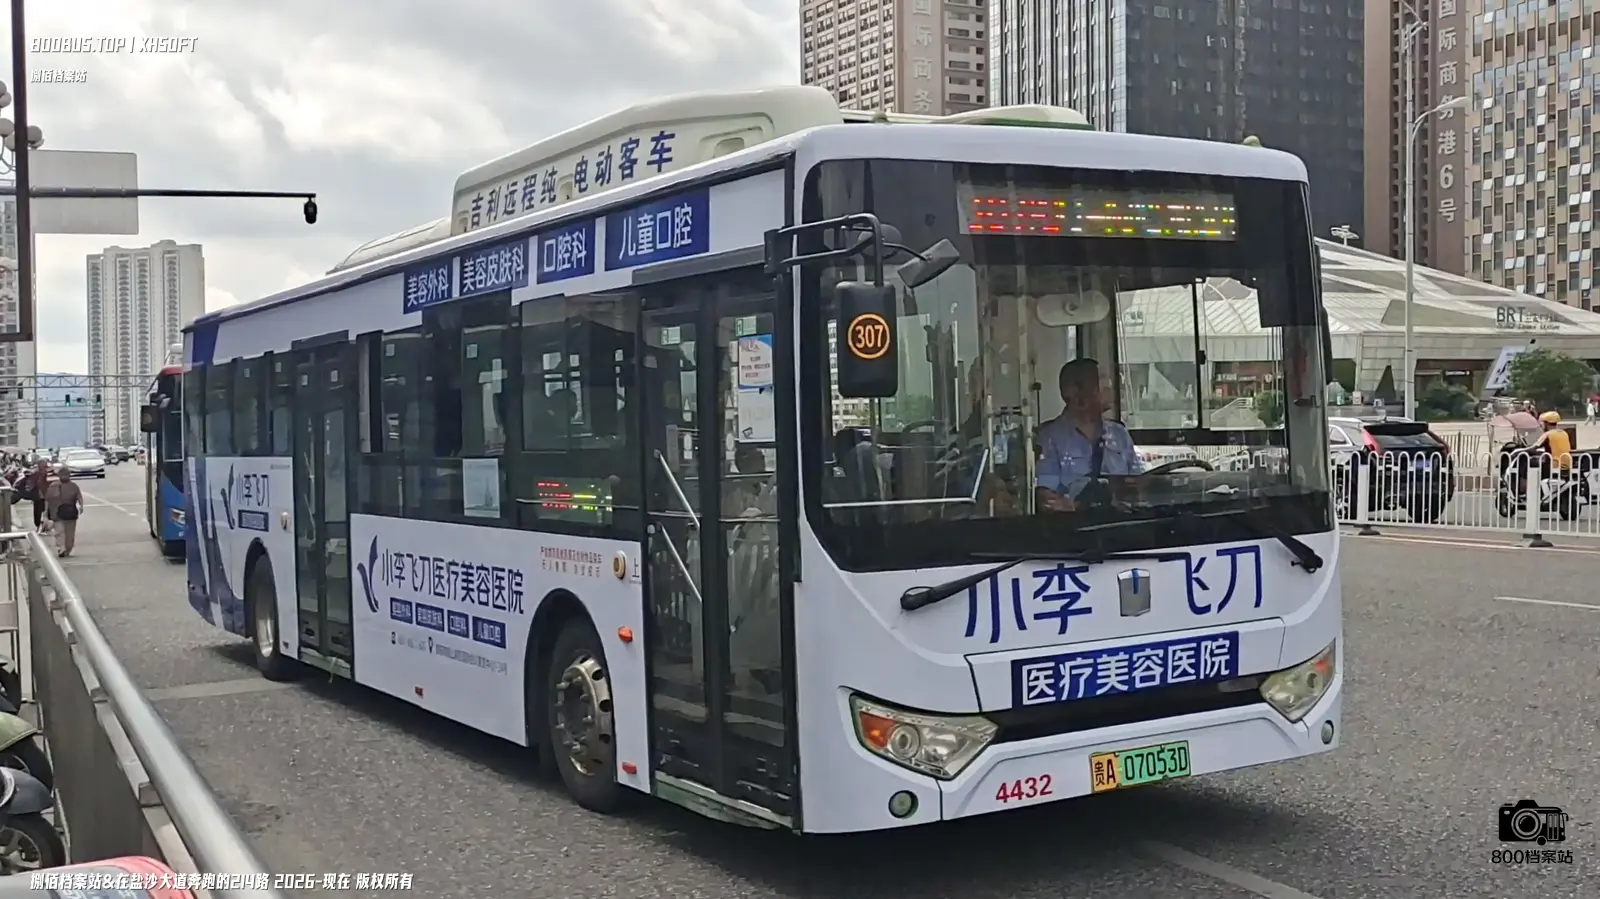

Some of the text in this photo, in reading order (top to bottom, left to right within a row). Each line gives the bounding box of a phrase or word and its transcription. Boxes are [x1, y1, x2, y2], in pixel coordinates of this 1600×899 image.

[543, 228, 587, 273] 口腔科
[619, 203, 693, 260] 儿童口腔
[407, 265, 449, 308] 美容外科
[463, 244, 525, 293] 美容皮肤科
[855, 324, 884, 348] 307
[1497, 307, 1525, 322] BRT
[381, 548, 525, 615] 小李飞刀医疗美容医院
[1022, 638, 1230, 706] 医疗美容医院
[996, 774, 1052, 803] 4432
